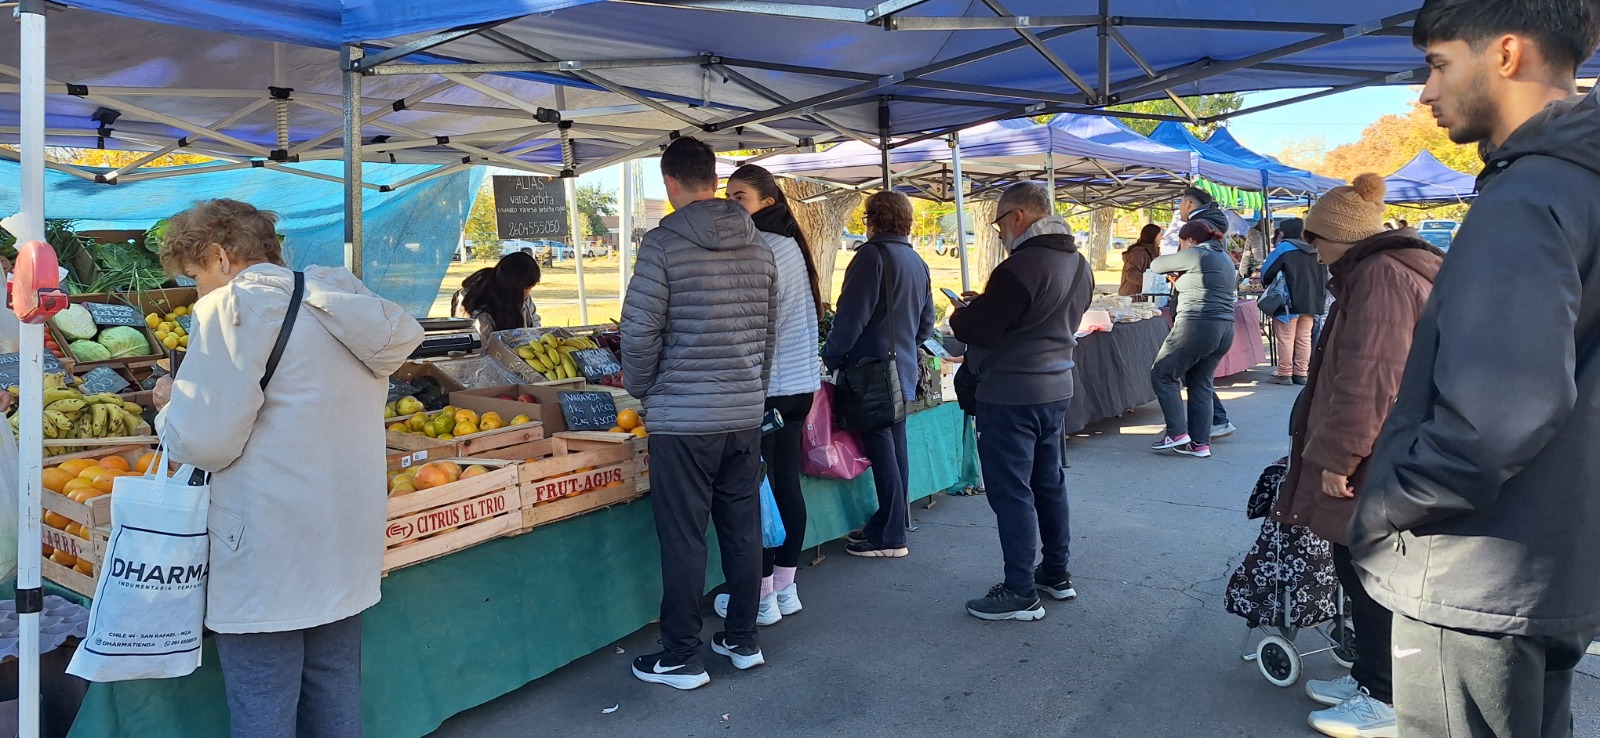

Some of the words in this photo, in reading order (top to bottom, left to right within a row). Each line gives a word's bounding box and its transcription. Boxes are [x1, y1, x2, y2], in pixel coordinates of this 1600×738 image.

[515, 176, 545, 191] ALIAS
[508, 219, 560, 237] 2604555050
[564, 393, 602, 402] NARANJA
[590, 403, 615, 413] $1800
[593, 414, 617, 426] $3000
[535, 468, 622, 503] FRUT-AGUS
[416, 507, 460, 534] CITRUS
[463, 503, 478, 522] EL
[478, 495, 506, 517] TRIO
[111, 557, 210, 585] DHARMA
[118, 581, 172, 591] INDUMENTARIA
[102, 640, 156, 648] DHARMATIENDA
